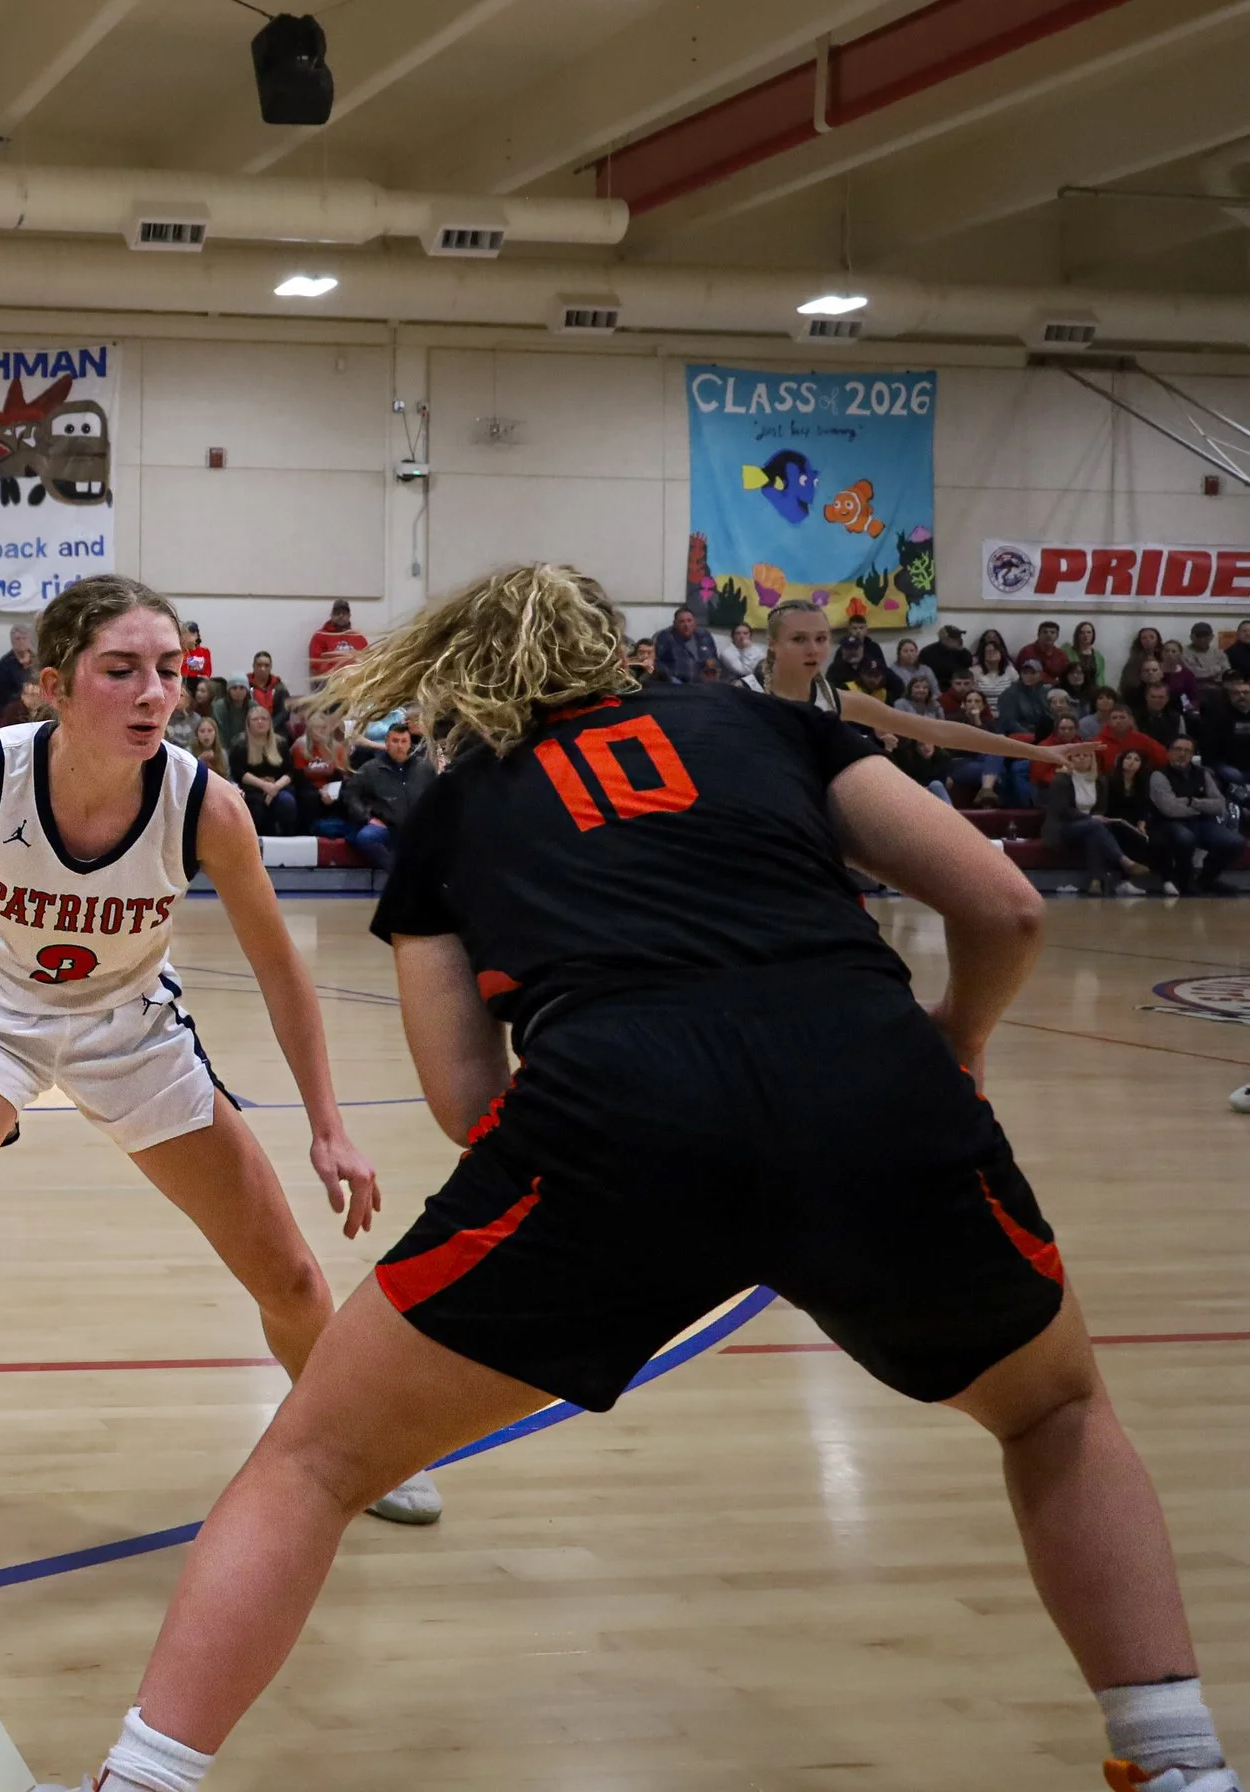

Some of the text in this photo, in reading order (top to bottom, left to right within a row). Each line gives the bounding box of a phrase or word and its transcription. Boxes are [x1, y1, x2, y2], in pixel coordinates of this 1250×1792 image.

[692, 373, 932, 416] CLASS of 2026
[58, 536, 104, 557] and
[1034, 547, 1250, 597] PRIDE
[533, 714, 699, 832] 10
